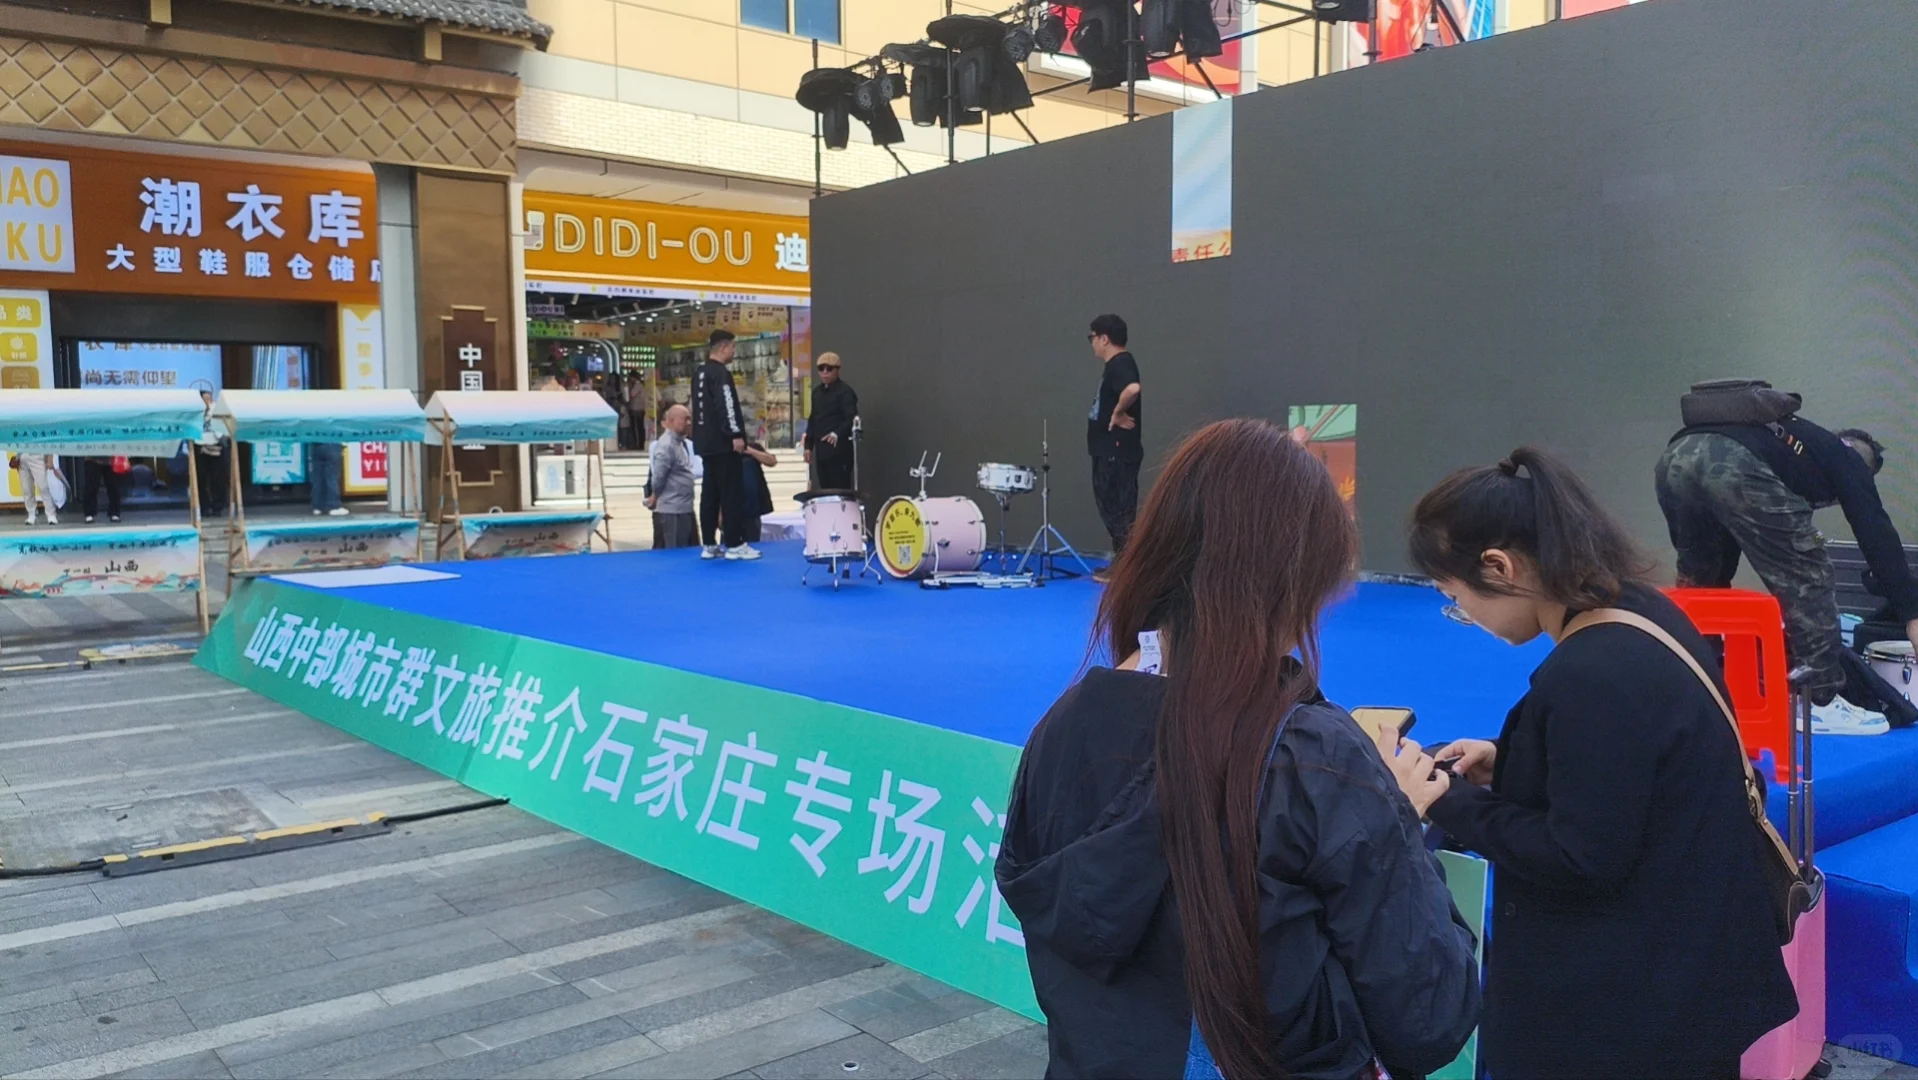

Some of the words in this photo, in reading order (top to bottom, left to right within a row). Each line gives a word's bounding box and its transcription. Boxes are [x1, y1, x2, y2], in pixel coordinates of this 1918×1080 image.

[0, 166, 60, 208] AO
[139, 177, 364, 247] 潮衣库
[6, 221, 62, 263] KU
[554, 212, 751, 266] DIDI-OU
[775, 232, 809, 273] 迪
[459, 343, 484, 391] 中国
[105, 560, 139, 573] 山西
